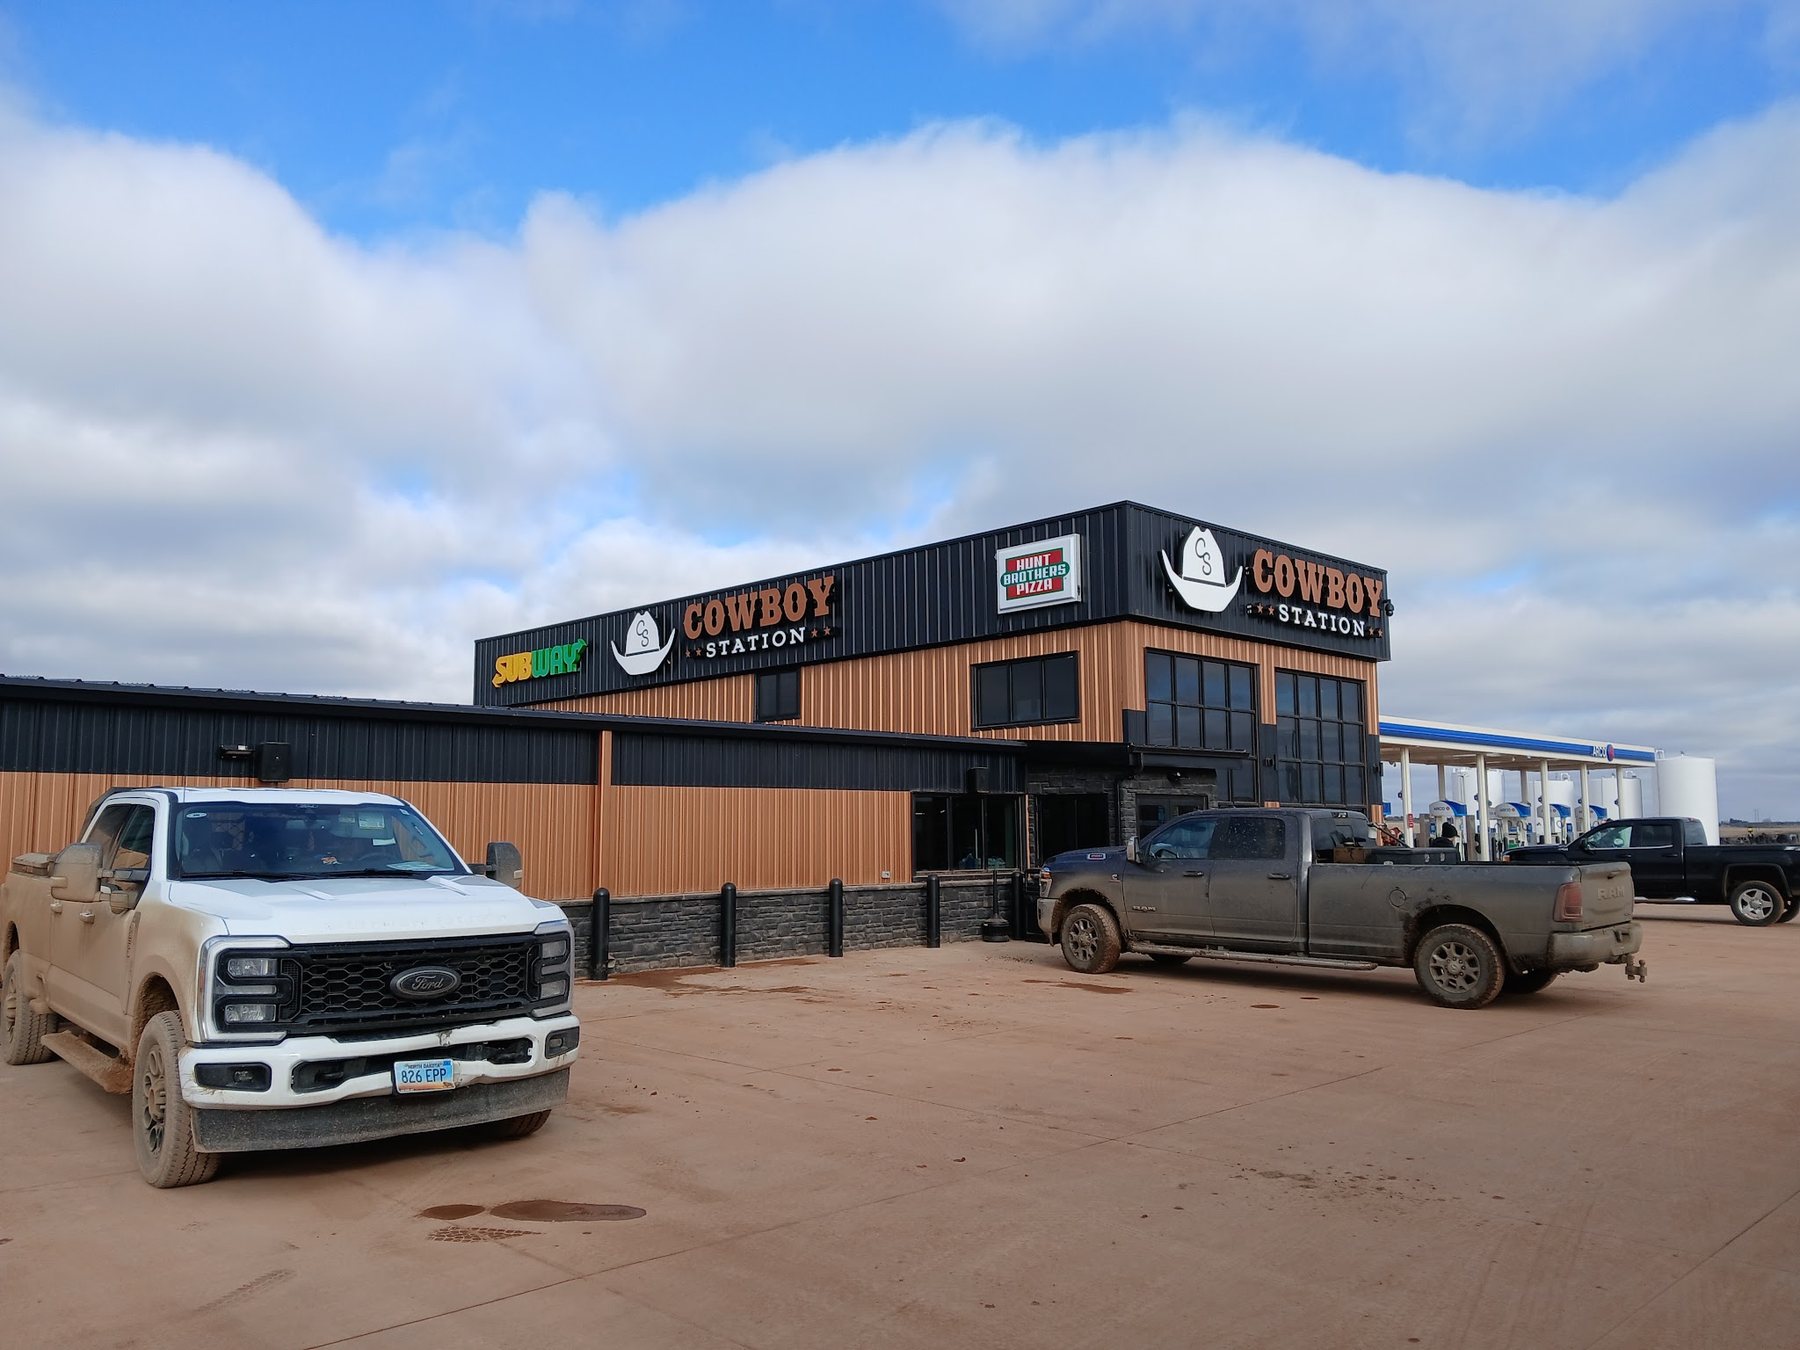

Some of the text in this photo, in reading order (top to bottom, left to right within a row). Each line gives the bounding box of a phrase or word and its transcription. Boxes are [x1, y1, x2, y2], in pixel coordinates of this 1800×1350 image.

[1003, 564, 1067, 586] BROTHERS
[1016, 553, 1051, 571] HUNT
[1016, 578, 1053, 595] PIZZA
[1253, 548, 1383, 618] COWBOY
[683, 575, 835, 640] COWBOY
[1278, 603, 1365, 637] STATION
[706, 626, 806, 658] STATION
[492, 638, 588, 688] SUBWAY
[411, 975, 444, 991] Ford
[401, 1068, 446, 1083] 826 EPP
